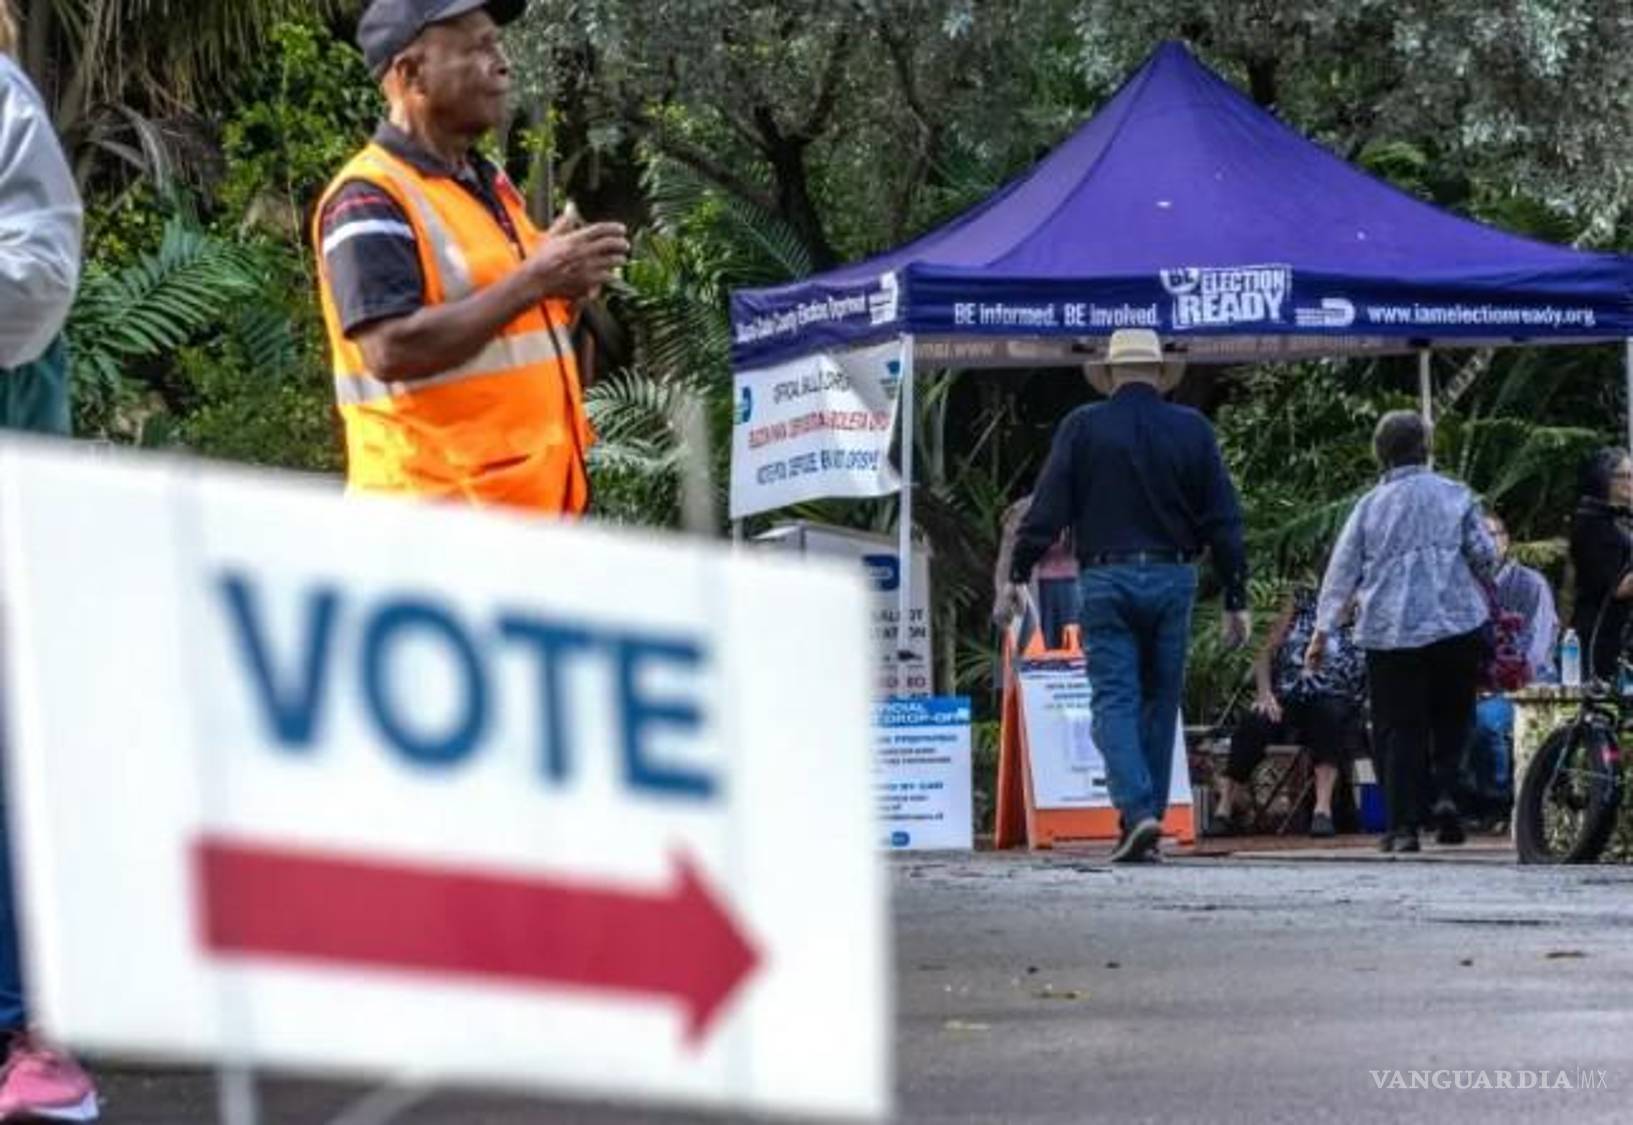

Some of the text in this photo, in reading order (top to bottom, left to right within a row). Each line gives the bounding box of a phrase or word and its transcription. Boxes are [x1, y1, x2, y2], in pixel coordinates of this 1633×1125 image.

[1201, 269, 1285, 293] ELECTION
[954, 302, 1159, 327] BE informed. BE involved.
[1178, 290, 1285, 325] READY
[211, 567, 722, 801] VOTE
